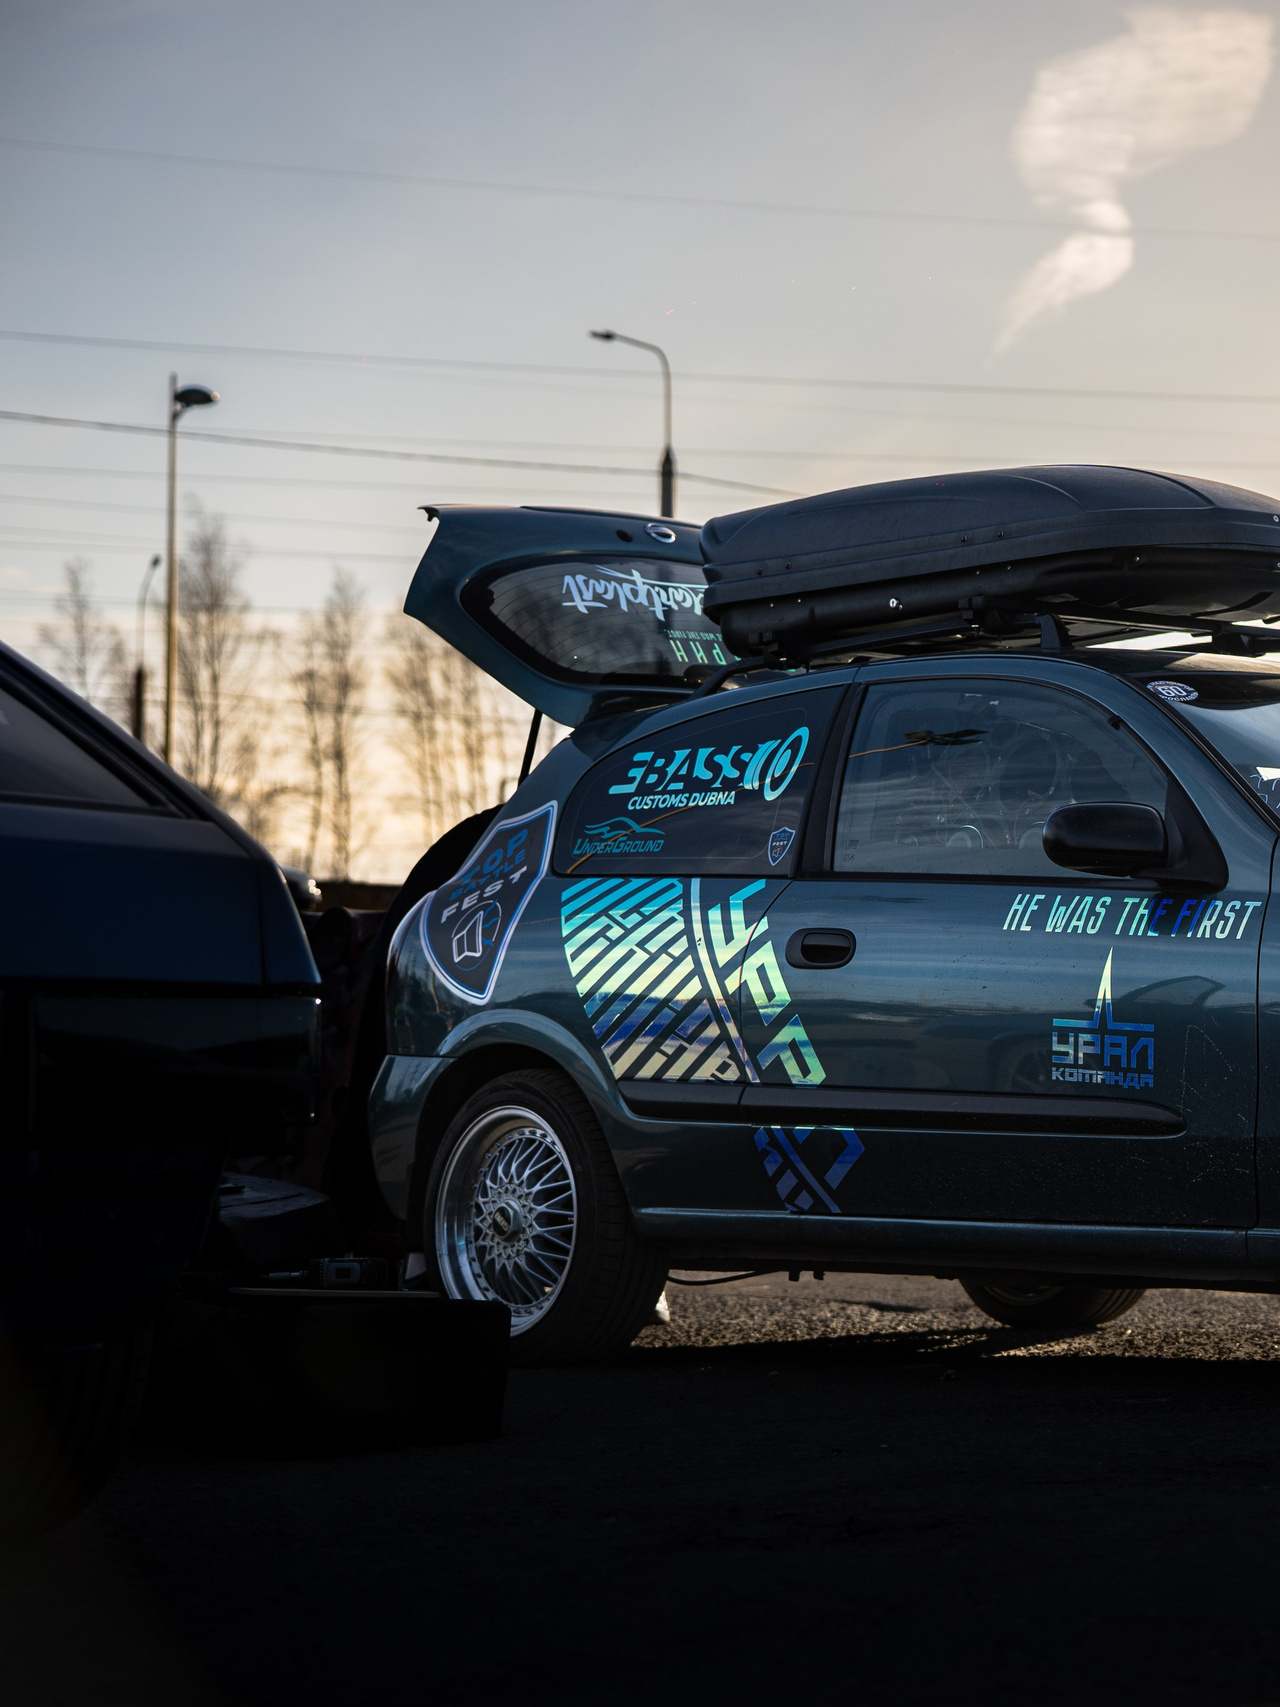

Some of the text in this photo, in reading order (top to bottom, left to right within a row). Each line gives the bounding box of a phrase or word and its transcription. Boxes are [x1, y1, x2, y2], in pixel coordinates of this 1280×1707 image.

[628, 790, 736, 810] CUSTOMS DUBNA
[450, 849, 525, 900] BATTLE
[460, 829, 528, 886] TOP
[441, 865, 528, 924] FEST
[1002, 893, 1262, 940] HE WAS THE FIRST
[1051, 1031, 1155, 1070] УРАЛ
[1051, 1067, 1155, 1090] КОМАНДА
